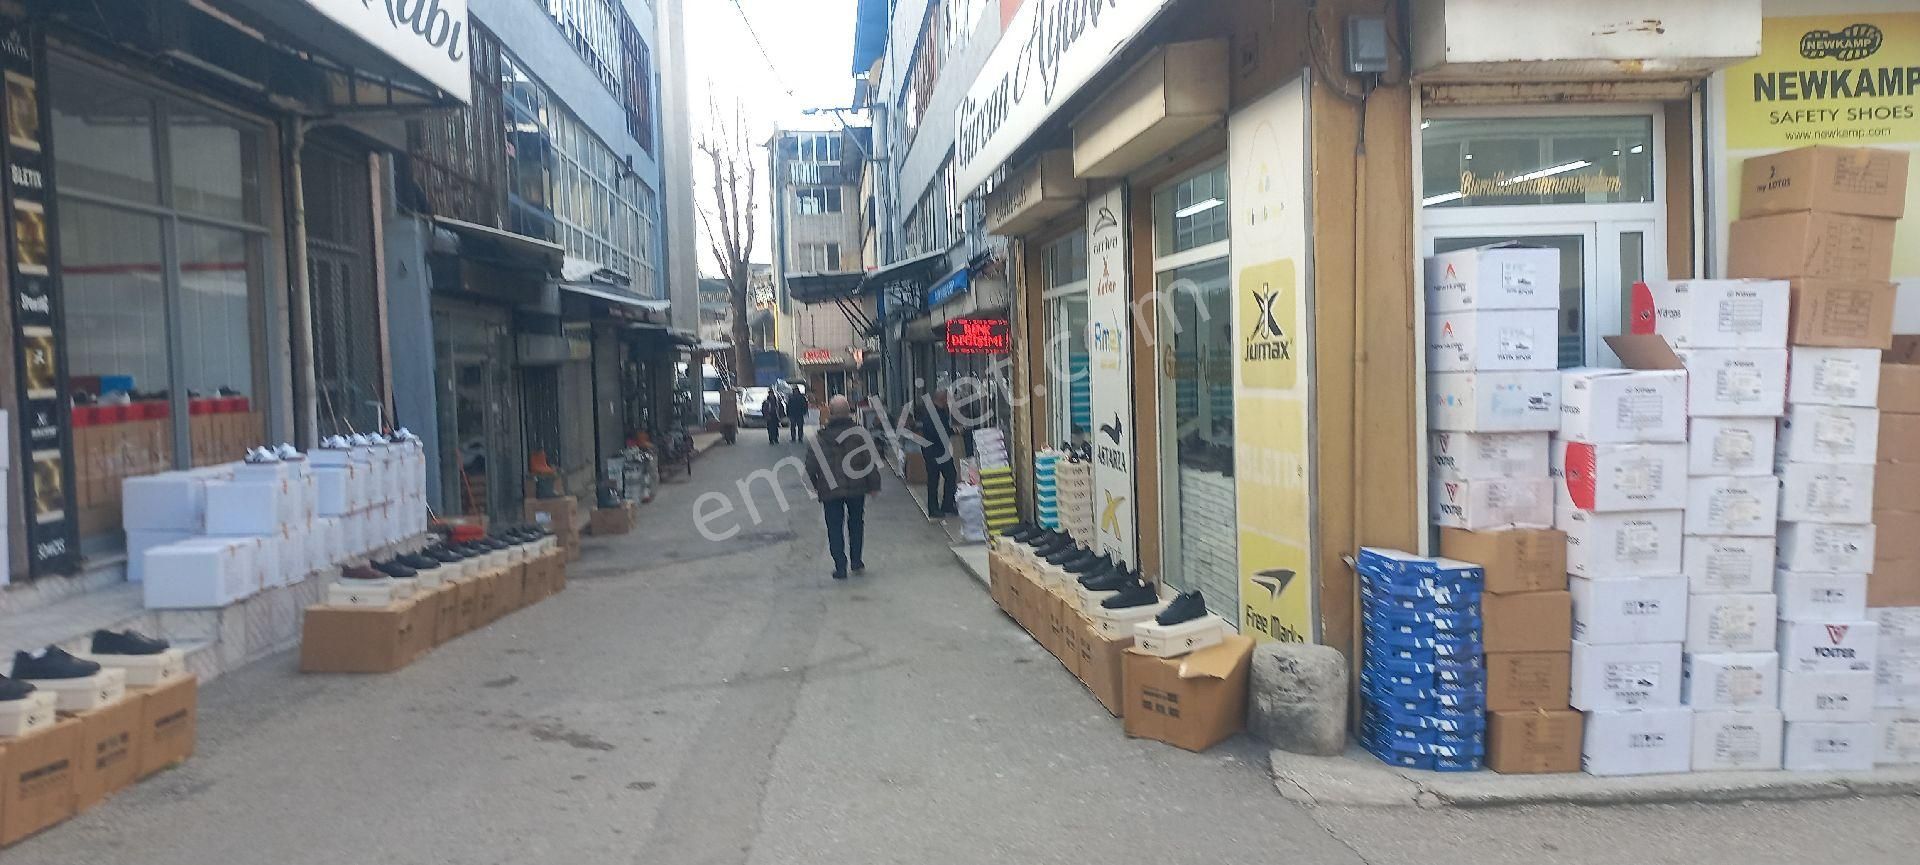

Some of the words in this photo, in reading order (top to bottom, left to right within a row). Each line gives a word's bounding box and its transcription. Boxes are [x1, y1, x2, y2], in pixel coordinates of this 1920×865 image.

[1806, 38, 1872, 50] NEWKAMP
[1753, 66, 1920, 102] NEWKAMP
[959, 71, 1009, 171] Gürcan
[1769, 108, 1840, 125] SAFETY
[1847, 105, 1914, 121] SHOES
[1785, 127, 1891, 142] www.newkamp.com
[1245, 337, 1290, 362] jumax
[1245, 603, 1268, 635] Free
